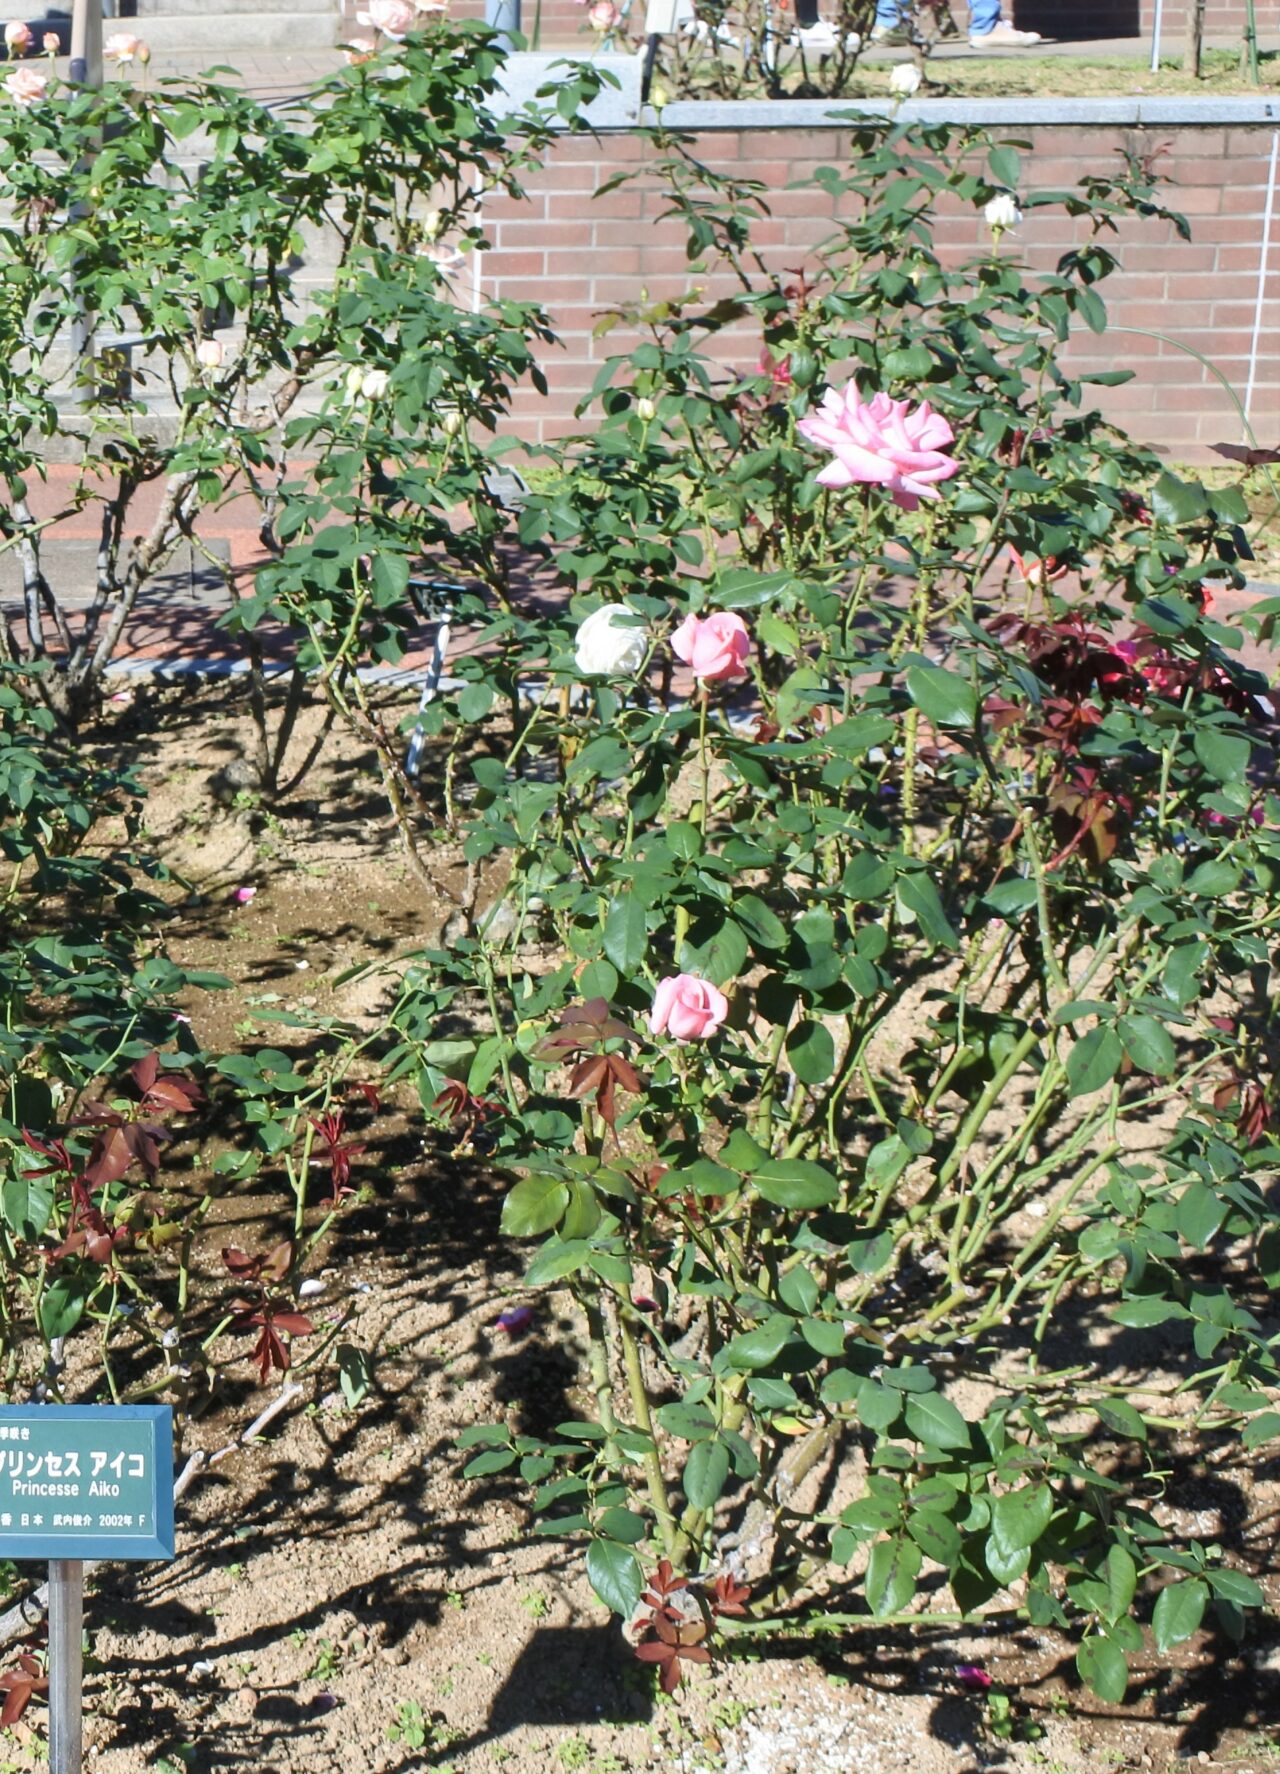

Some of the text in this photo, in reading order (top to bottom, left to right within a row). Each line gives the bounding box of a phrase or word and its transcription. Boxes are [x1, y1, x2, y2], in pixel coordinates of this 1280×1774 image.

[89, 1451, 145, 1478] アイコ
[12, 1480, 120, 1497] Princesse Aiko
[20, 1513, 43, 1527] 日本
[99, 1513, 133, 1527] 2002年
[138, 1513, 146, 1527] F
